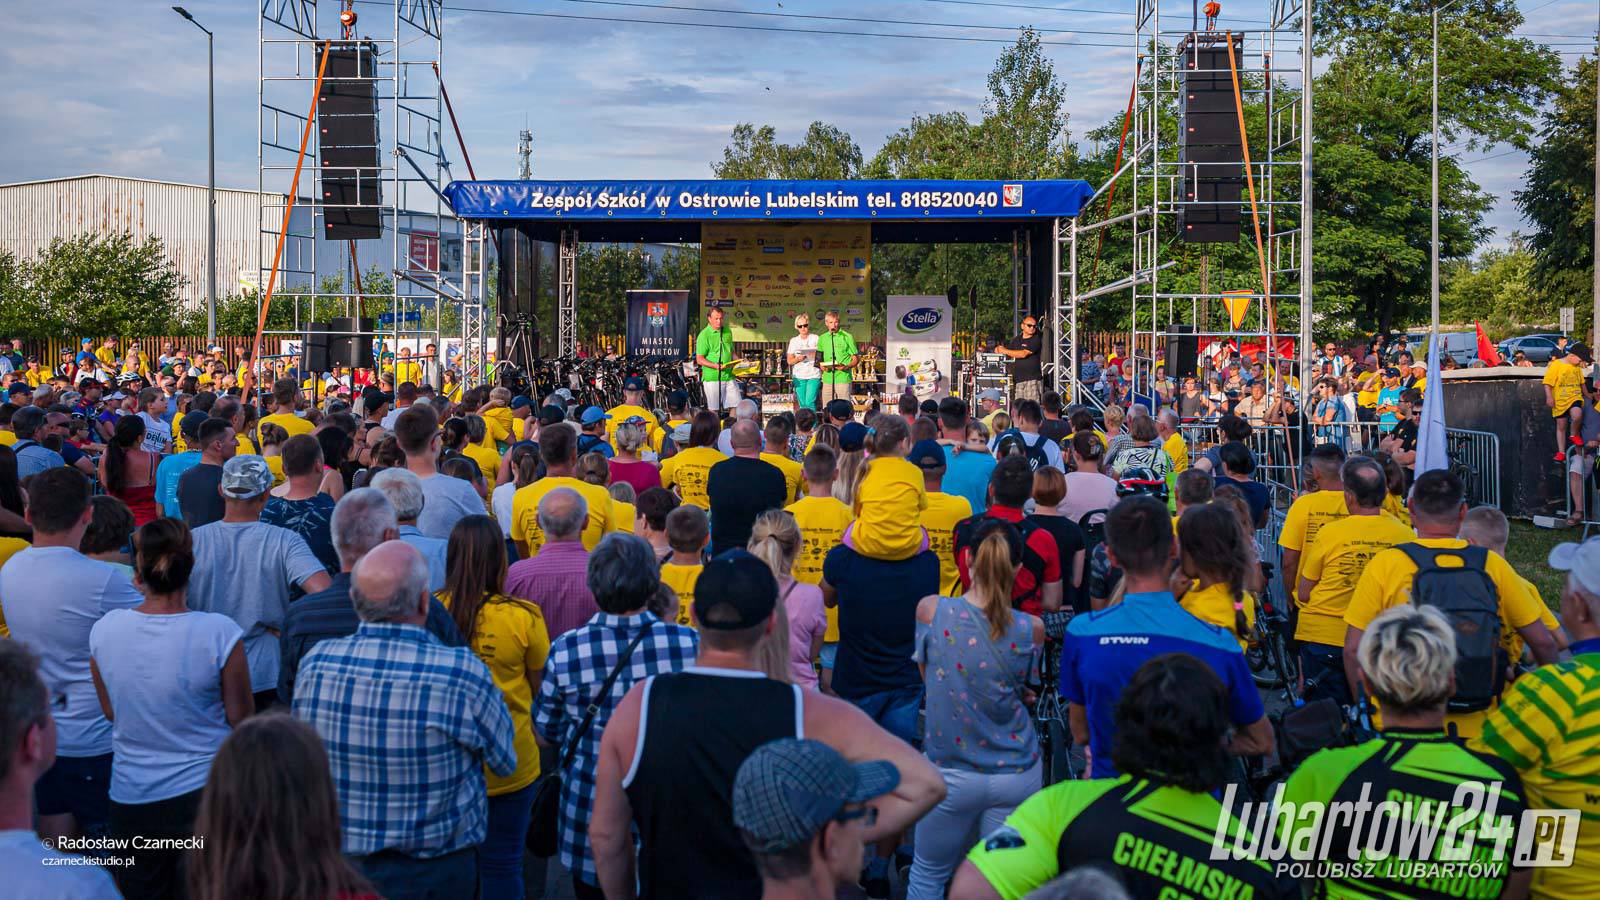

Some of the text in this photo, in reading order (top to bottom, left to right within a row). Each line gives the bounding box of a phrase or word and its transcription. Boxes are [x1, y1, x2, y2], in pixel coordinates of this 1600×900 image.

[531, 190, 998, 212] Zespół Szkół w Ostrowie Lubelskim tel. 818520040
[906, 312, 937, 324] Stella
[641, 337, 674, 345] MIASTO
